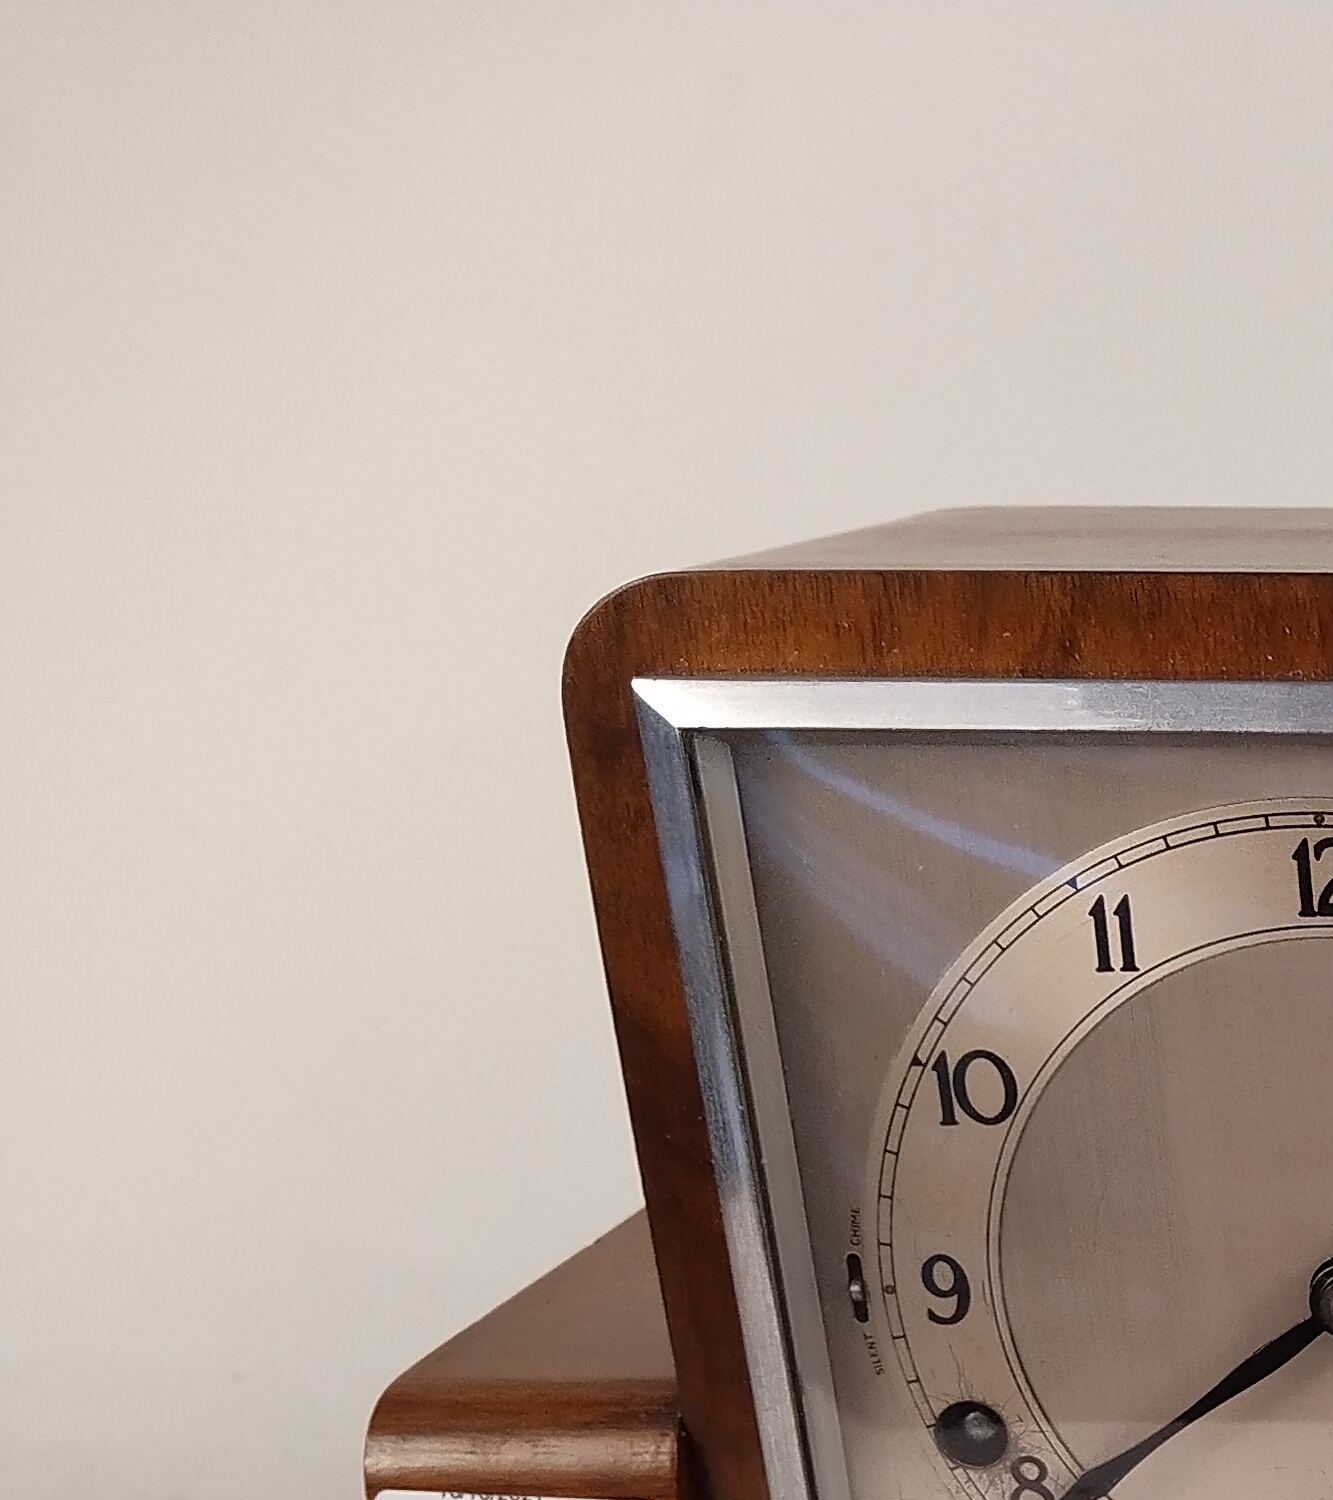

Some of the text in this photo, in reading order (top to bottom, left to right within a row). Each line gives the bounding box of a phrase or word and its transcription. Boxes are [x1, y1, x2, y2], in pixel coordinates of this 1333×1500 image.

[1089, 895, 1139, 973] 11
[931, 1050, 1017, 1126] 10
[850, 1206, 860, 1246] CHIME
[921, 1254, 971, 1326] 9
[864, 1333, 884, 1375] SILENT
